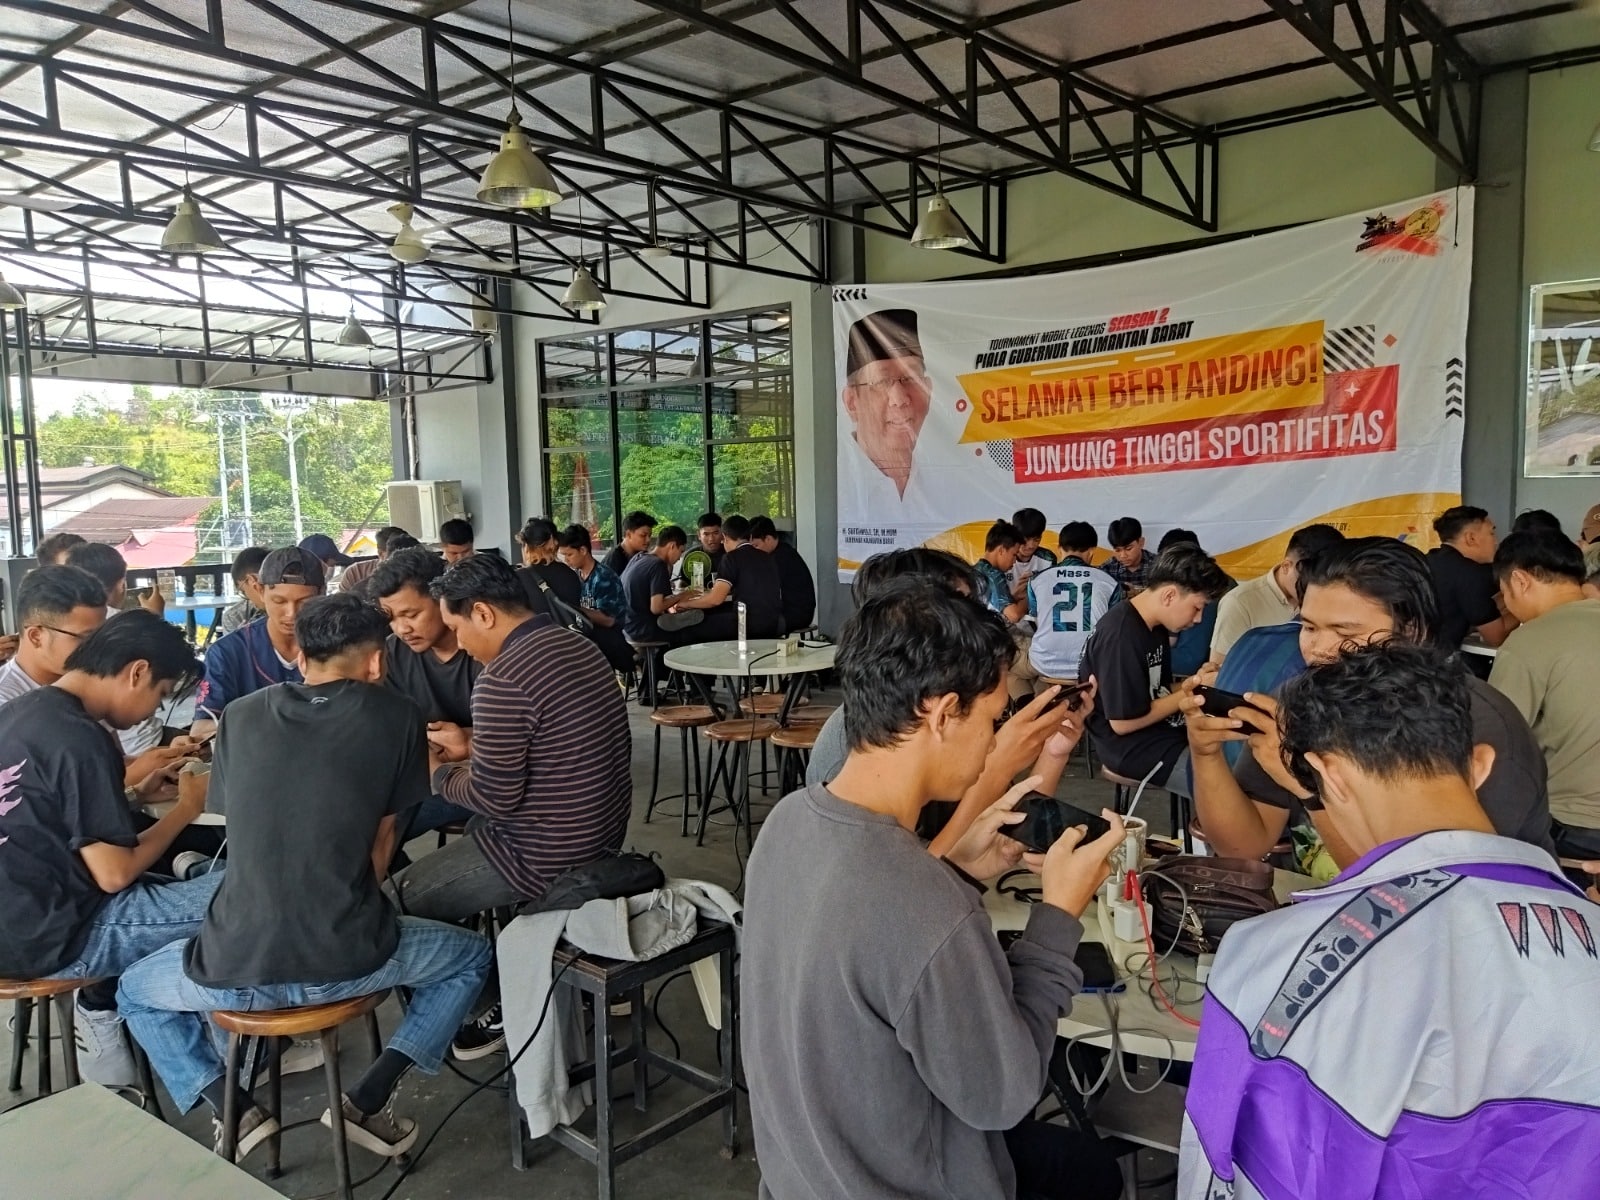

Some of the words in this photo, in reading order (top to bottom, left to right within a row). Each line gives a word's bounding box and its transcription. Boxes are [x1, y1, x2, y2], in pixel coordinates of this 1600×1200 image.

[975, 350, 1007, 369] PIALA
[1008, 342, 1069, 366] GUBERNUR
[1070, 327, 1149, 357] KALIMANTAN
[1151, 320, 1194, 345] BARAT
[989, 333, 1040, 351] TOURNAMENT
[1040, 328, 1071, 344] MOBILE
[1070, 322, 1107, 339] LEGENDS
[1107, 310, 1158, 333] SEASON
[1158, 307, 1171, 324] 2
[981, 376, 1100, 424] SELAMAT
[1108, 343, 1319, 410] BERTANDING!
[1024, 439, 1116, 476] JUNJUNG
[1123, 430, 1200, 467] TINGGI
[1208, 409, 1385, 460] SPORTIFITAS
[1056, 569, 1091, 578] Mass
[1052, 582, 1093, 632] 21
[1281, 934, 1360, 1020] diadora
